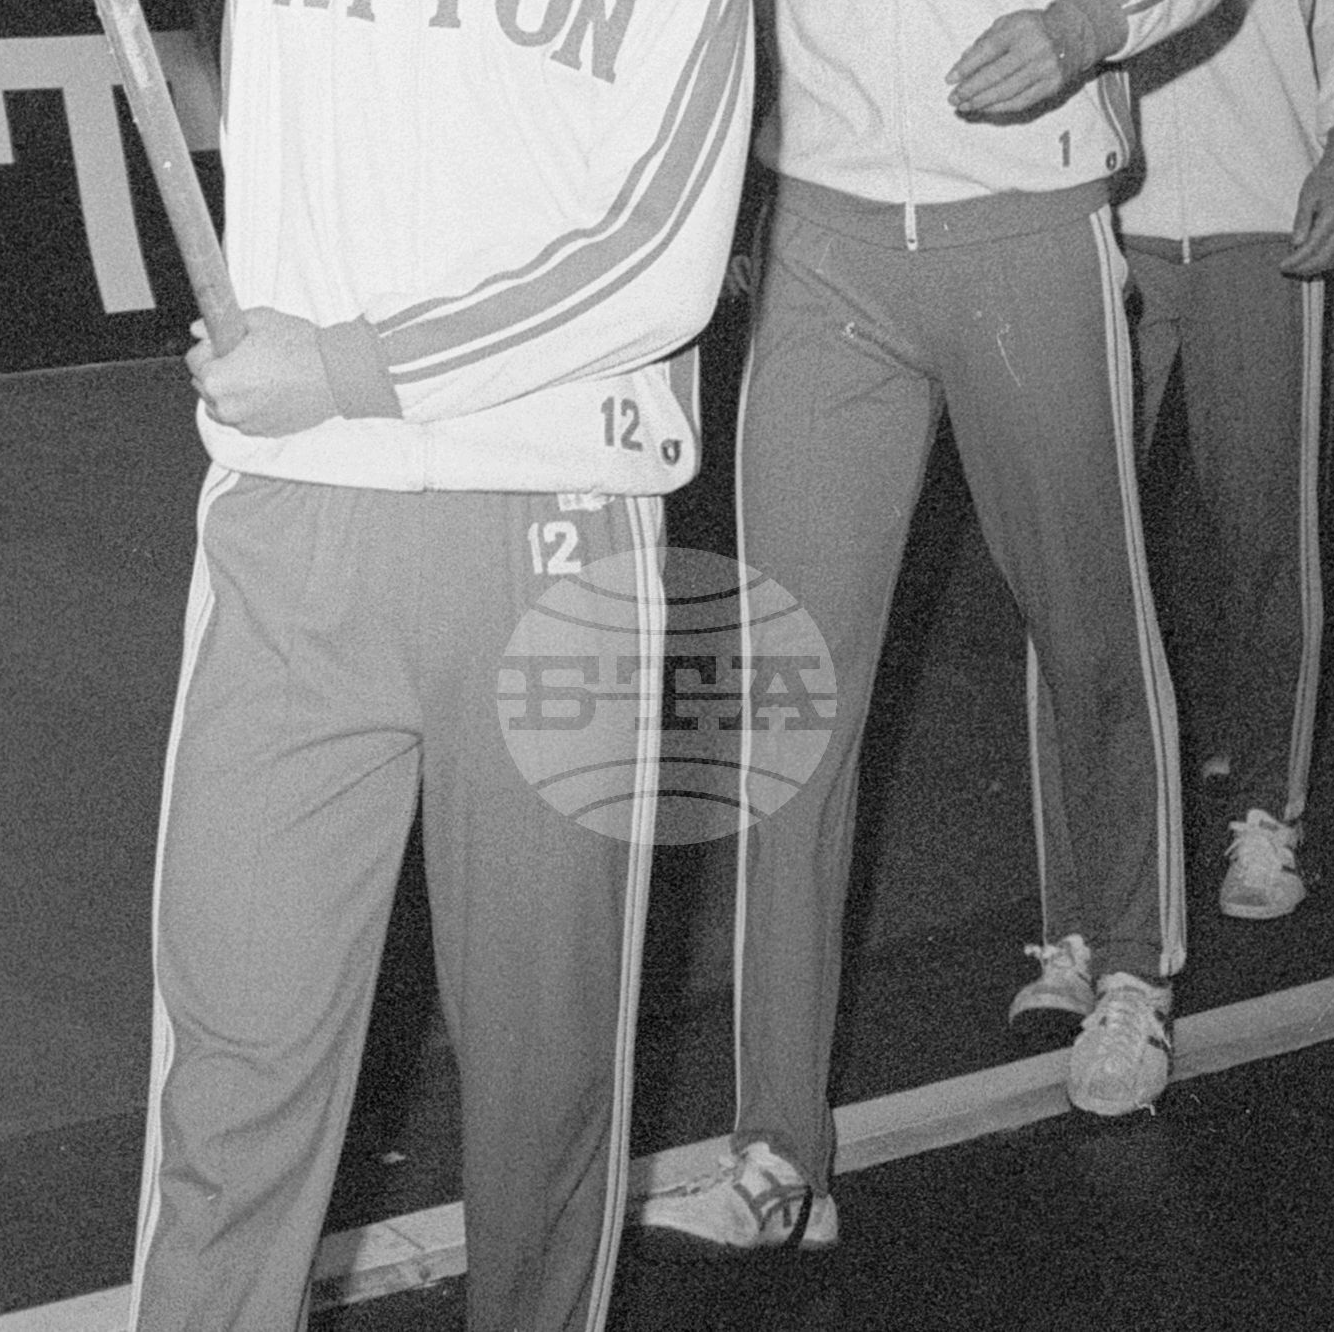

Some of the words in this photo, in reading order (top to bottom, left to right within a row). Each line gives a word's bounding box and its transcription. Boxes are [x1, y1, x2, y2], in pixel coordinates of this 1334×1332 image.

[1058, 129, 1071, 168] 1
[600, 395, 644, 453] 12
[527, 520, 582, 576] 12
